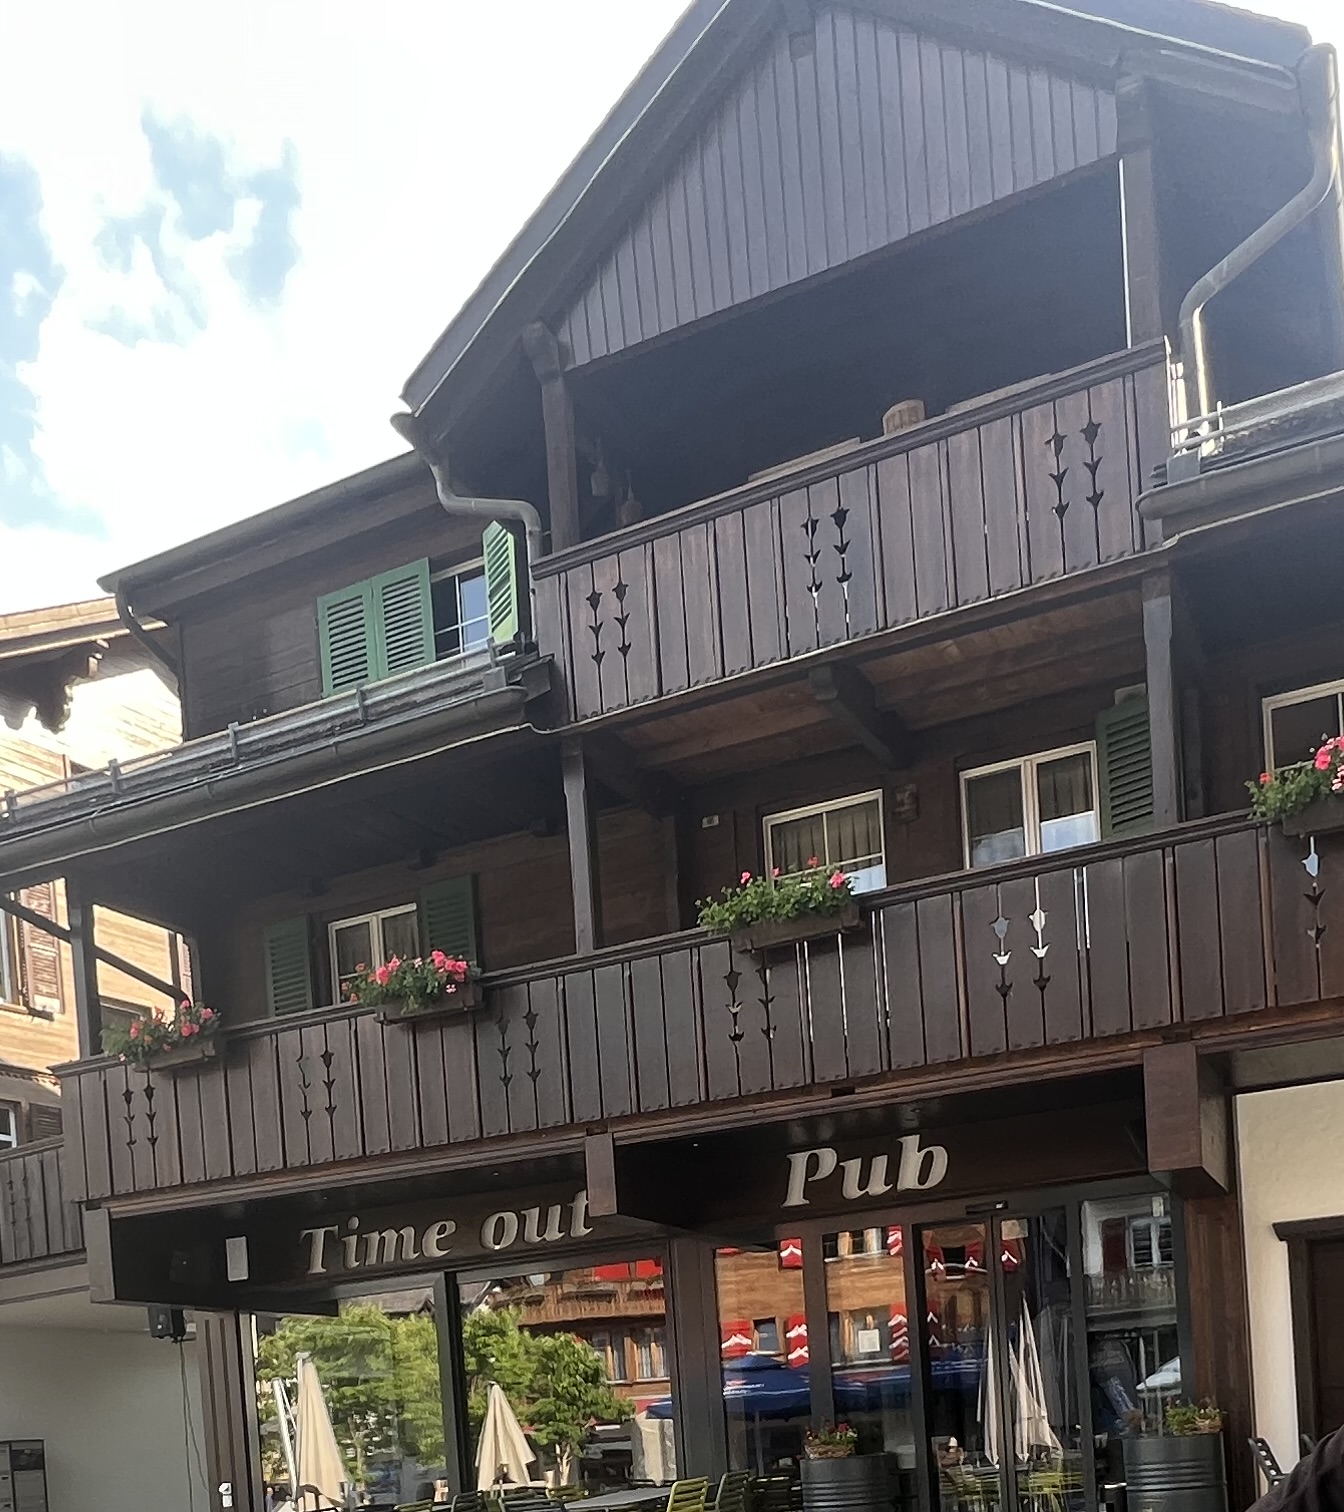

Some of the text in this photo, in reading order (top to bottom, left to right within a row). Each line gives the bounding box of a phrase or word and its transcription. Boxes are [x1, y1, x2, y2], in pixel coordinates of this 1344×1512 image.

[298, 1132, 950, 1277] Time out Pub
